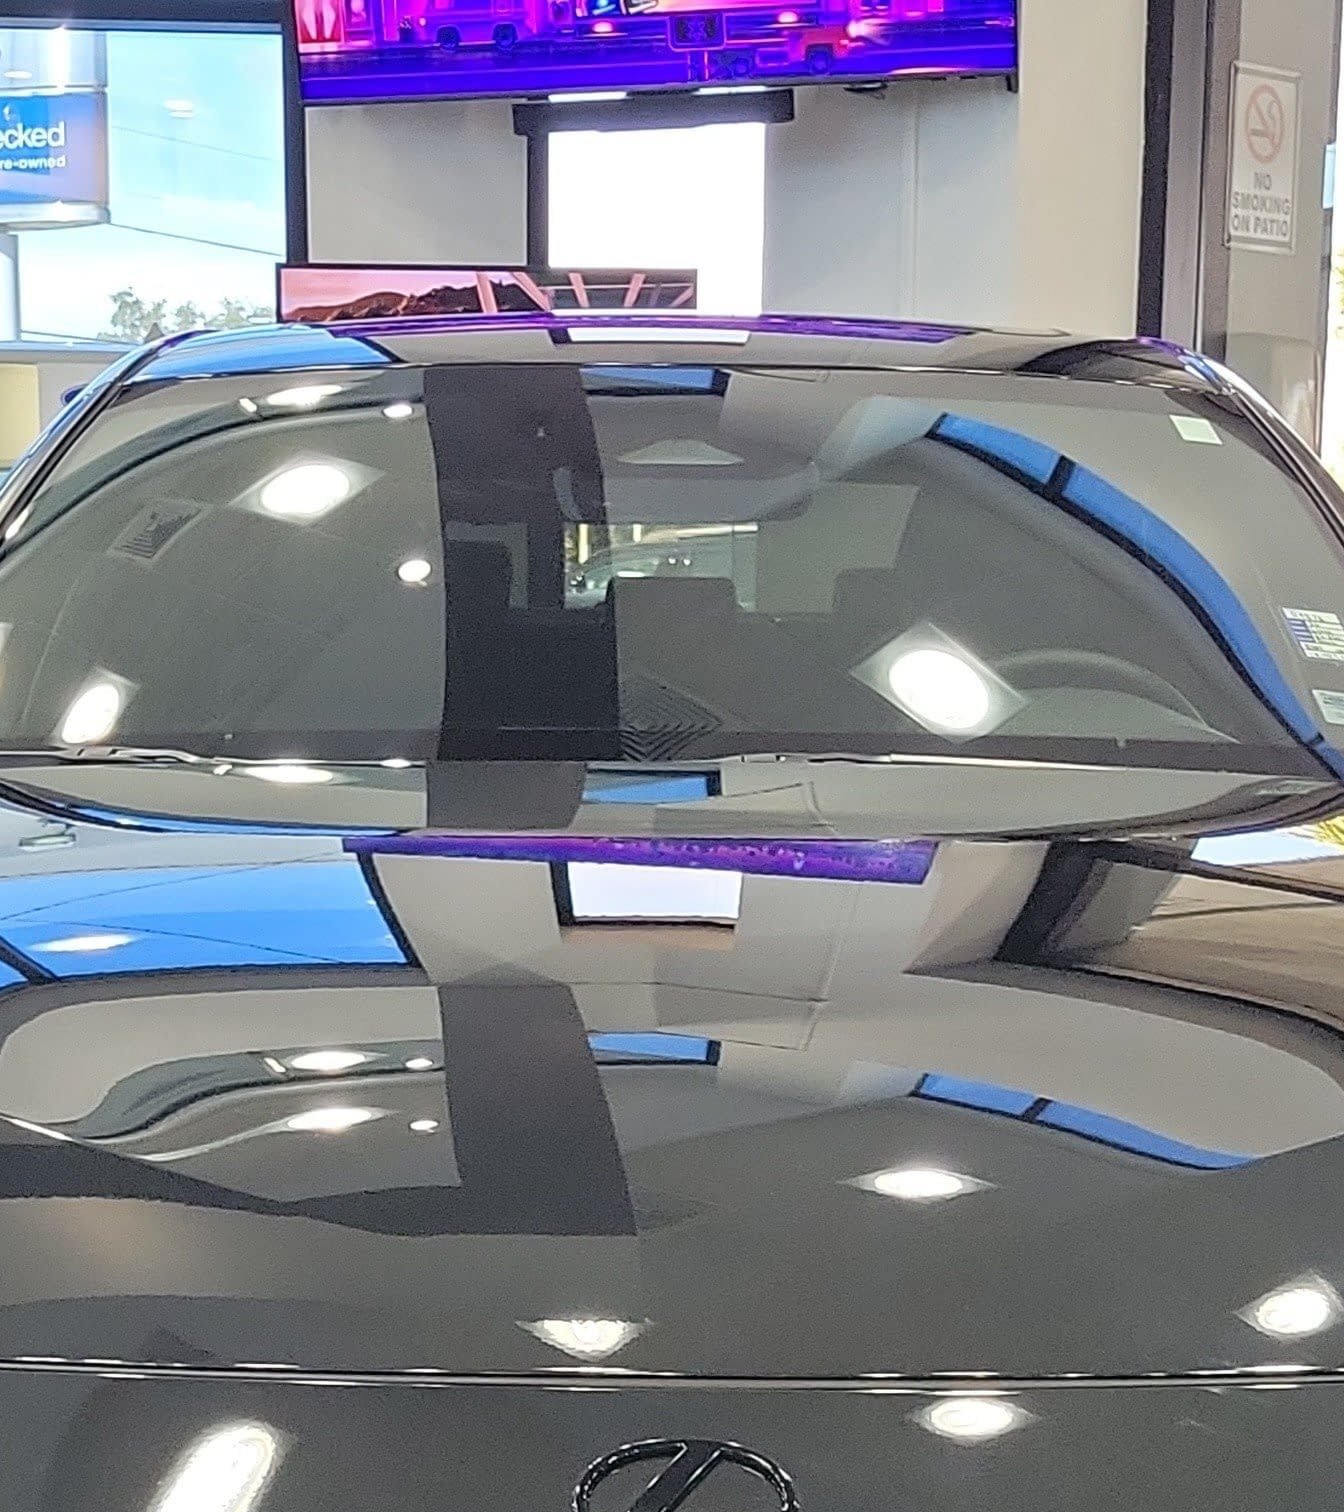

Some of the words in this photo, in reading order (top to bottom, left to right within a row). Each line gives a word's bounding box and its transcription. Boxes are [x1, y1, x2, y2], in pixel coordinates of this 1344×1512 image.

[1253, 171, 1273, 191] NO
[1231, 190, 1290, 216] SMOKING
[1231, 214, 1251, 232] ON
[1253, 215, 1289, 238] PATIO
